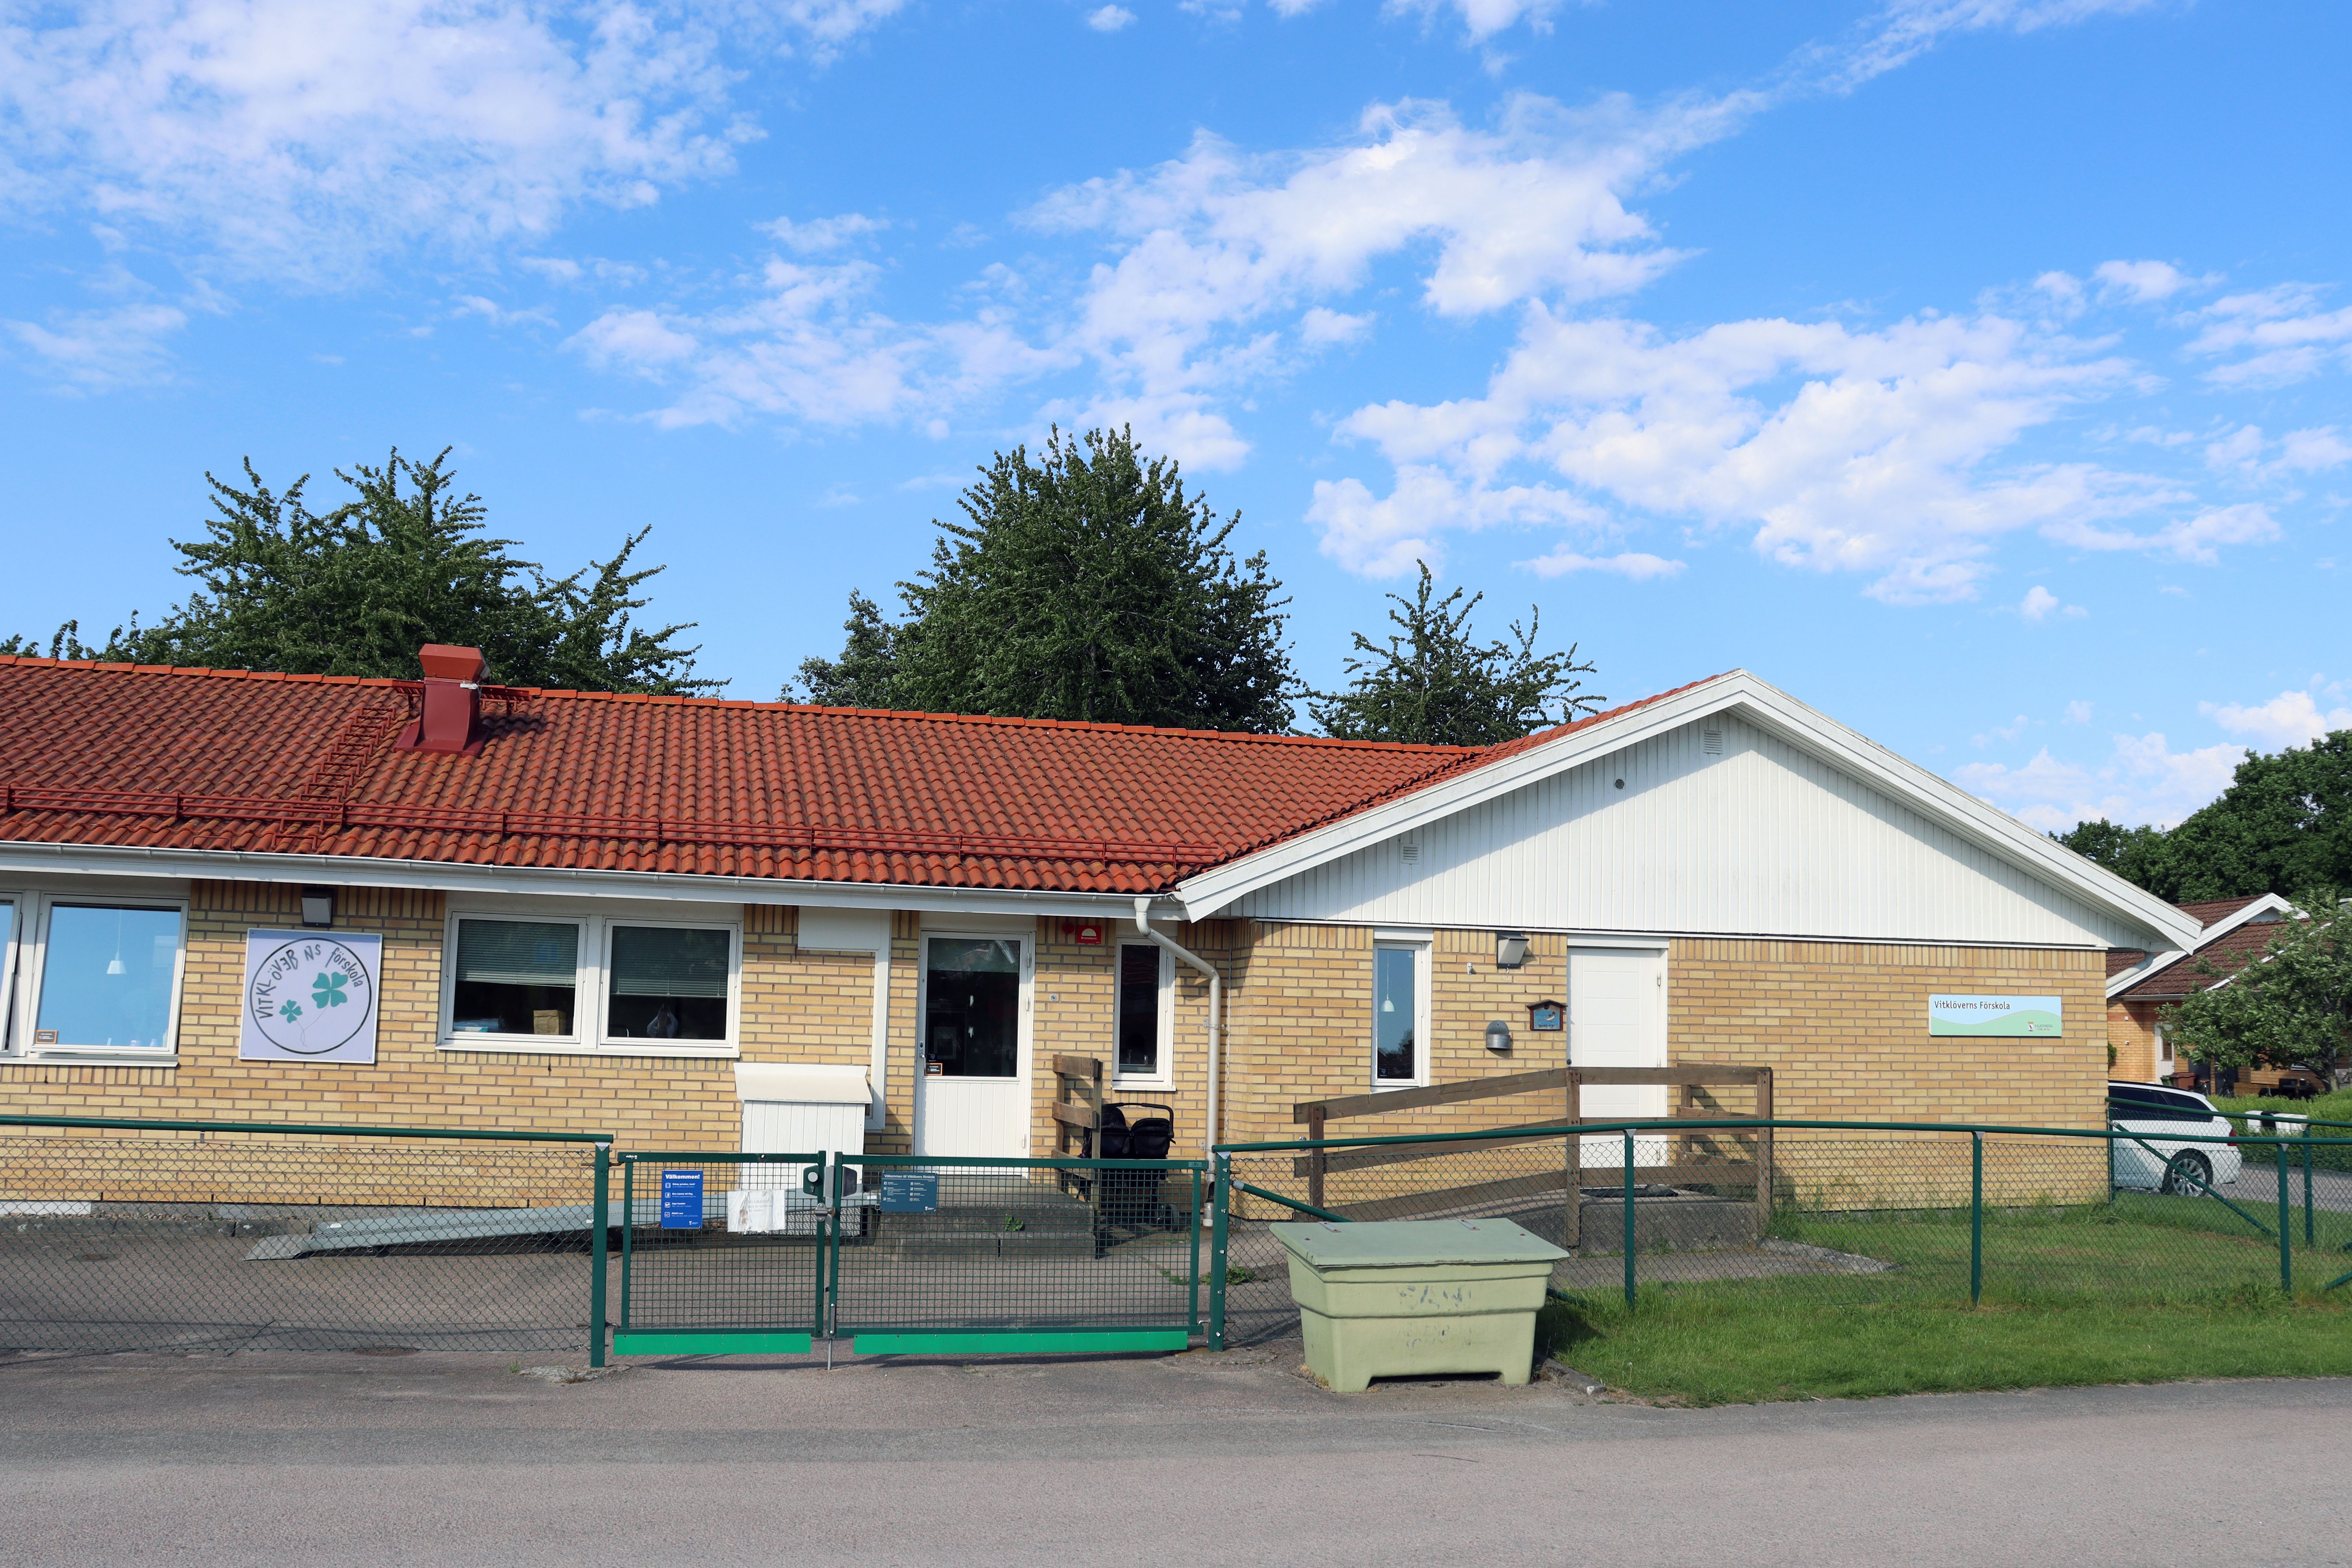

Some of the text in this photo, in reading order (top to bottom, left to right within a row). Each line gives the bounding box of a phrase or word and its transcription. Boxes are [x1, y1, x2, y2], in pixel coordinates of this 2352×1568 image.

[325, 947, 365, 987] förskola
[1935, 1000, 2010, 1009] Vitklöverns Förskola
